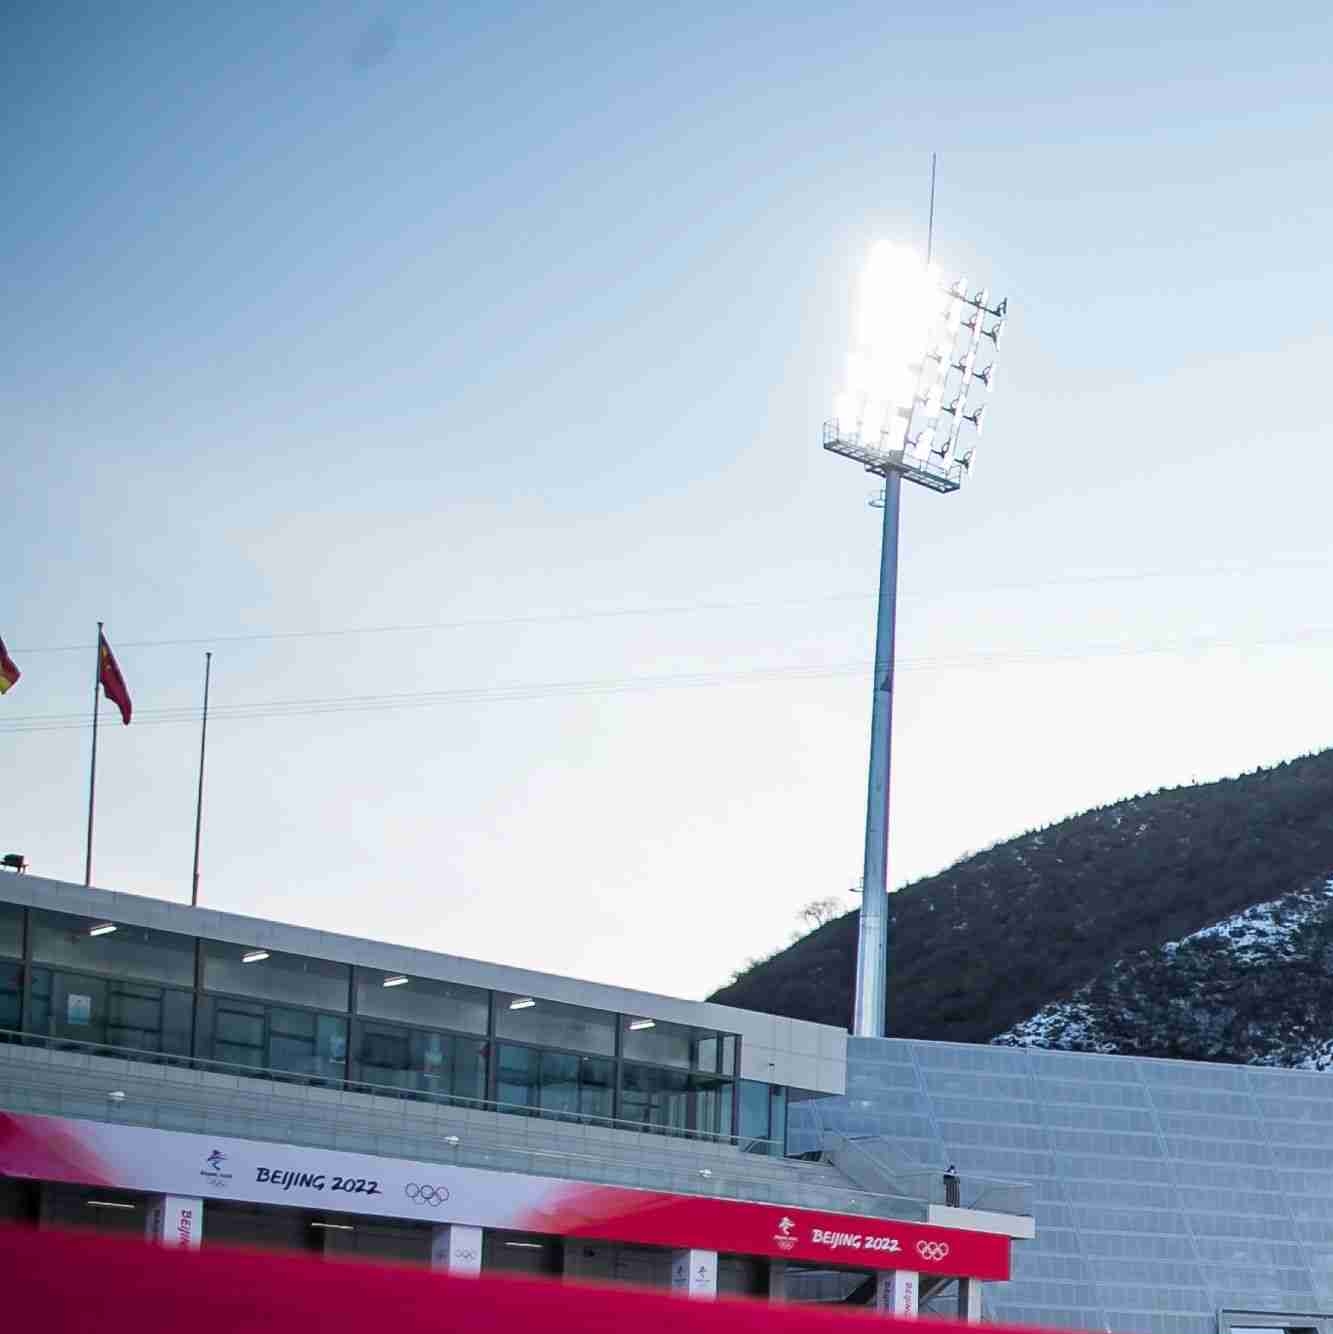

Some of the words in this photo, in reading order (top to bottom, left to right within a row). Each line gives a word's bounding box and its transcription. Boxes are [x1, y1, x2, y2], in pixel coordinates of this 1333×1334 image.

[255, 1167, 325, 1191] BEIJING
[331, 1177, 383, 1195] 2022
[811, 1228, 861, 1250] BEIJING
[864, 1236, 903, 1252] 2022
